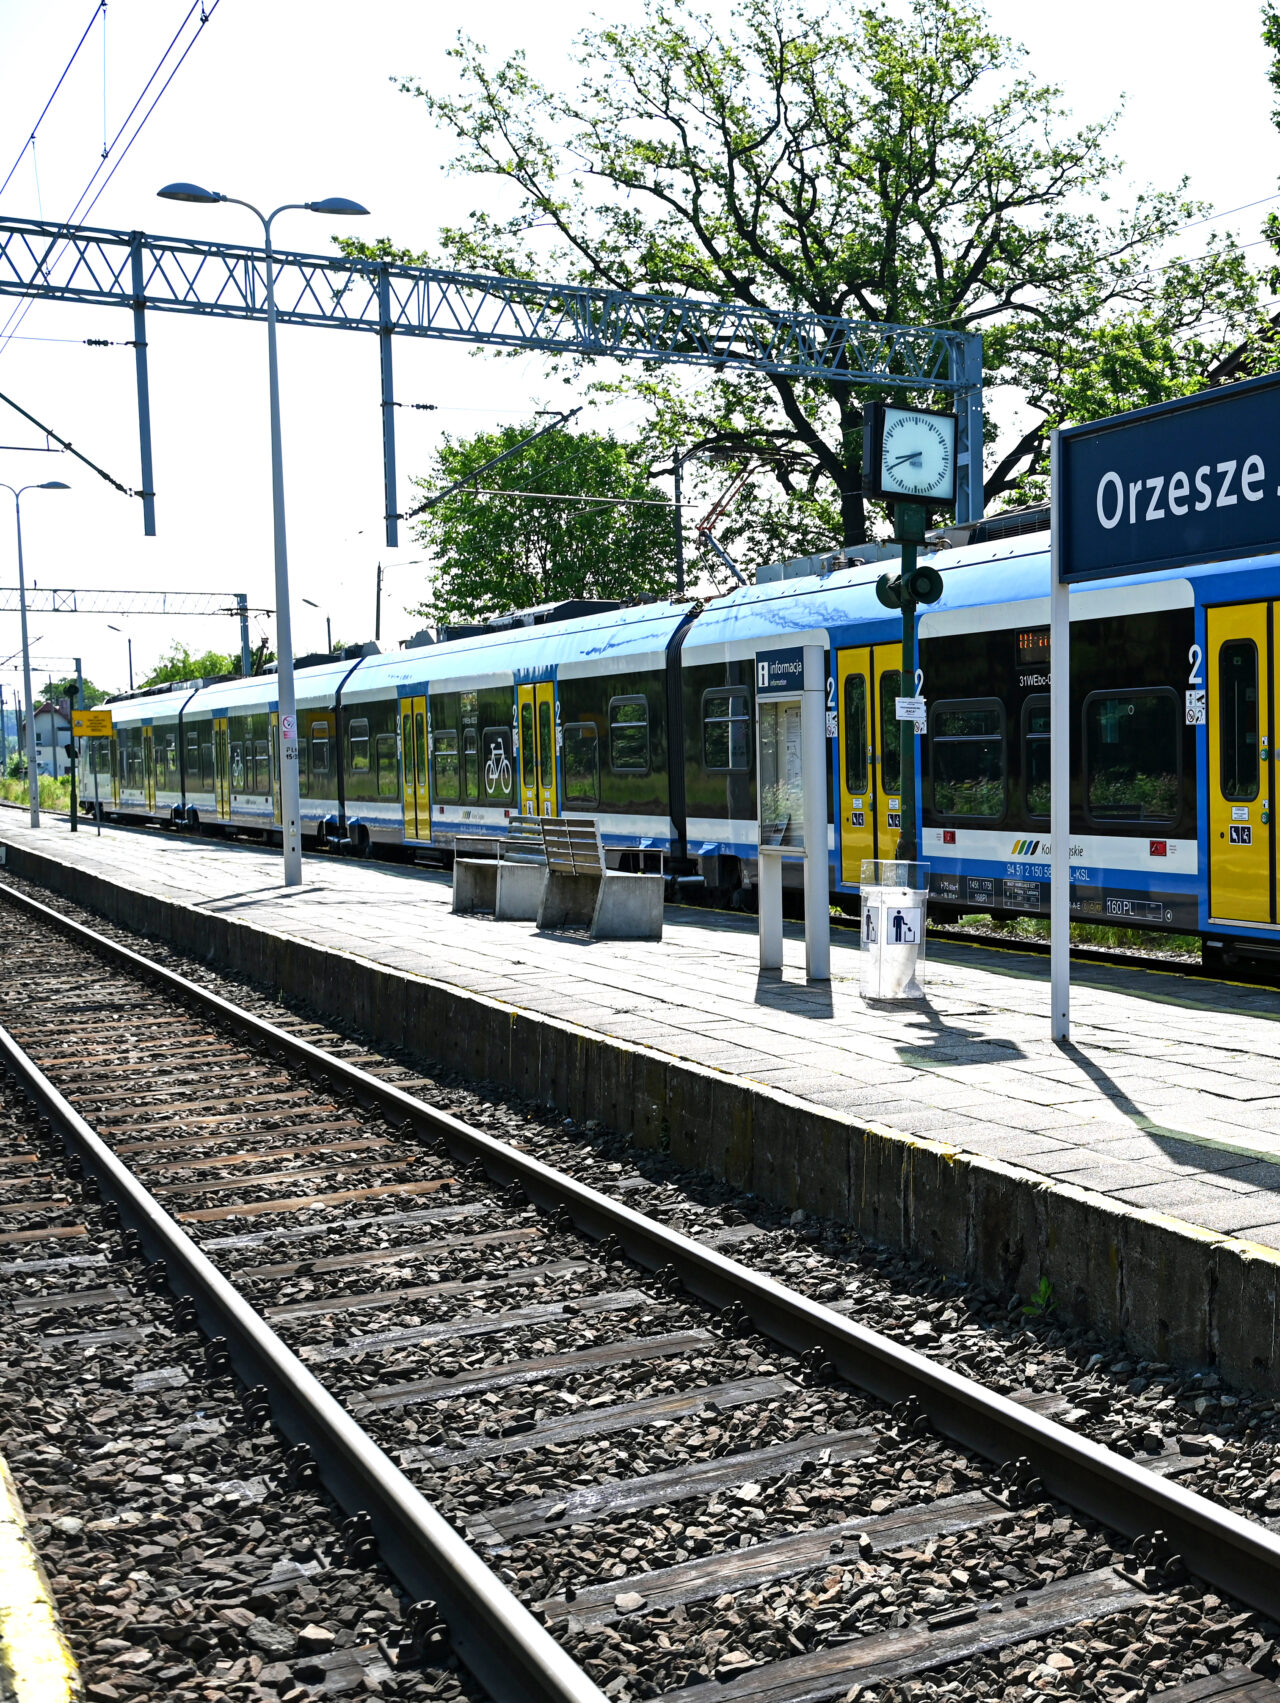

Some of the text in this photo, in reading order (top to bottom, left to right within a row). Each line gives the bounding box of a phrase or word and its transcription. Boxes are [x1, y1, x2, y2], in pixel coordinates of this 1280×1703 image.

[1096, 452, 1266, 530] Orzesze
[770, 659, 802, 676] informacja
[1188, 644, 1202, 684] 2
[826, 677, 835, 707] 2
[914, 668, 924, 699] 2
[512, 705, 518, 726] 2
[556, 701, 561, 724] 2
[1016, 864, 1024, 876] 51
[1025, 865, 1030, 876] 2
[1031, 865, 1043, 877] 150
[1107, 900, 1122, 914] 160
[1123, 901, 1134, 915] PL
